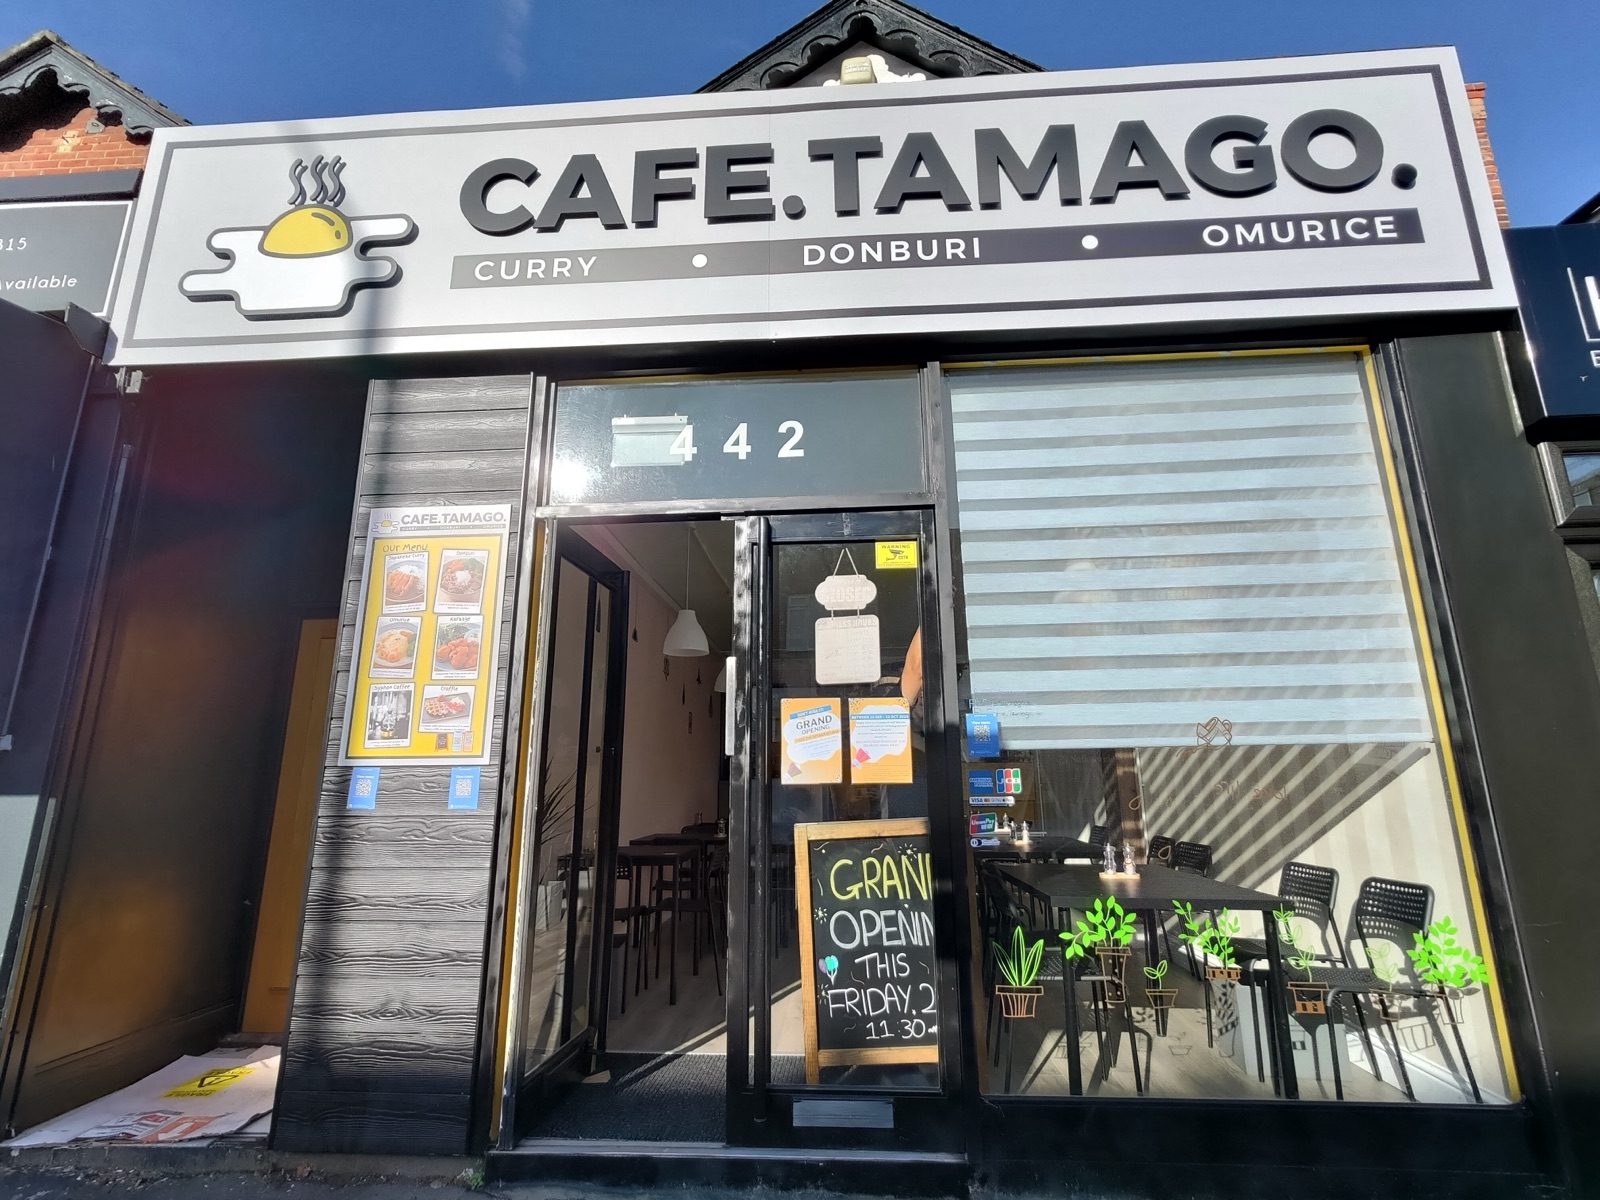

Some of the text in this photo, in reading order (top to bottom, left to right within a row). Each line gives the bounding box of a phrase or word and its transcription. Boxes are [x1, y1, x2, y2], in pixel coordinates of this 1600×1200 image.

[459, 108, 1418, 237] CAFE.TAMAGO.
[474, 215, 1398, 281] CURRY DONBURI OMURICE
[0, 274, 78, 291] vailable
[382, 544, 428, 553] Our Menu
[796, 715, 832, 730] GRAND
[801, 724, 831, 735] OPENING
[830, 852, 932, 900] GRAN
[855, 952, 910, 979] THIS
